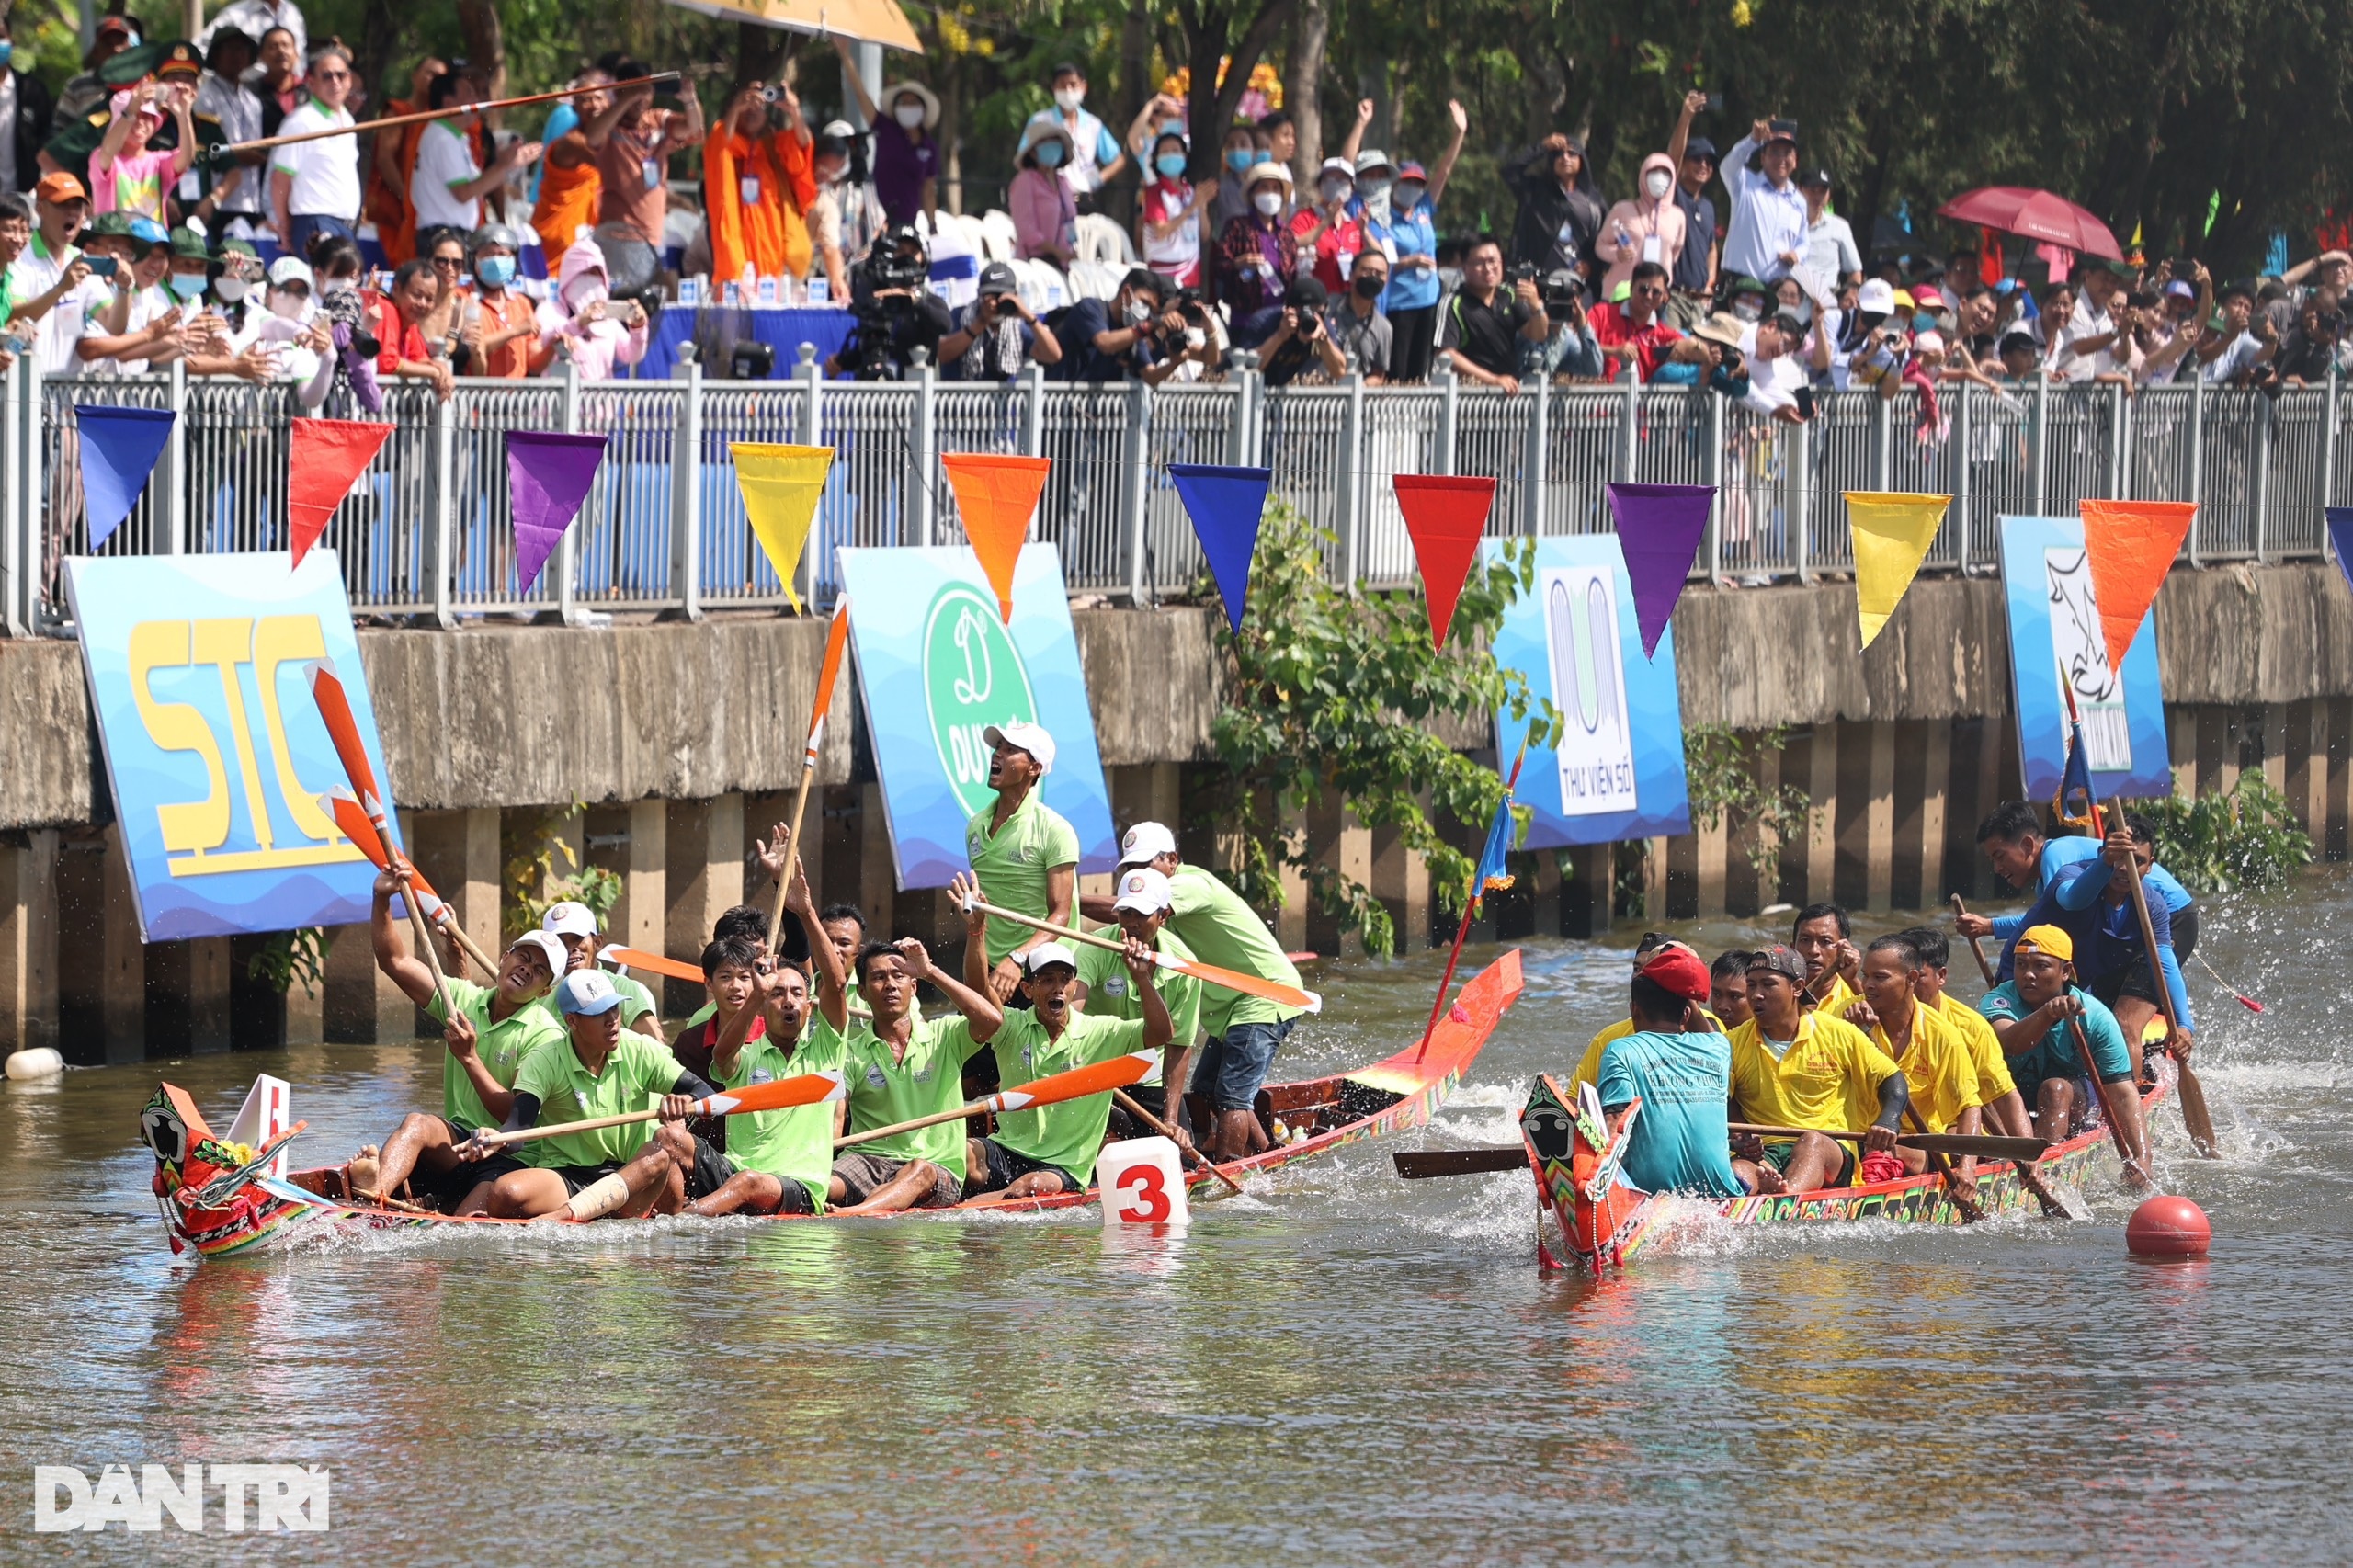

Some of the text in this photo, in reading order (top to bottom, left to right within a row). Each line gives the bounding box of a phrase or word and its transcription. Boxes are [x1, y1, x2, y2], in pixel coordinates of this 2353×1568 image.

[129, 614, 360, 851] STC
[1563, 752, 1631, 801] THƯ VIỆN SỐ
[1116, 1164, 1171, 1223] 3
